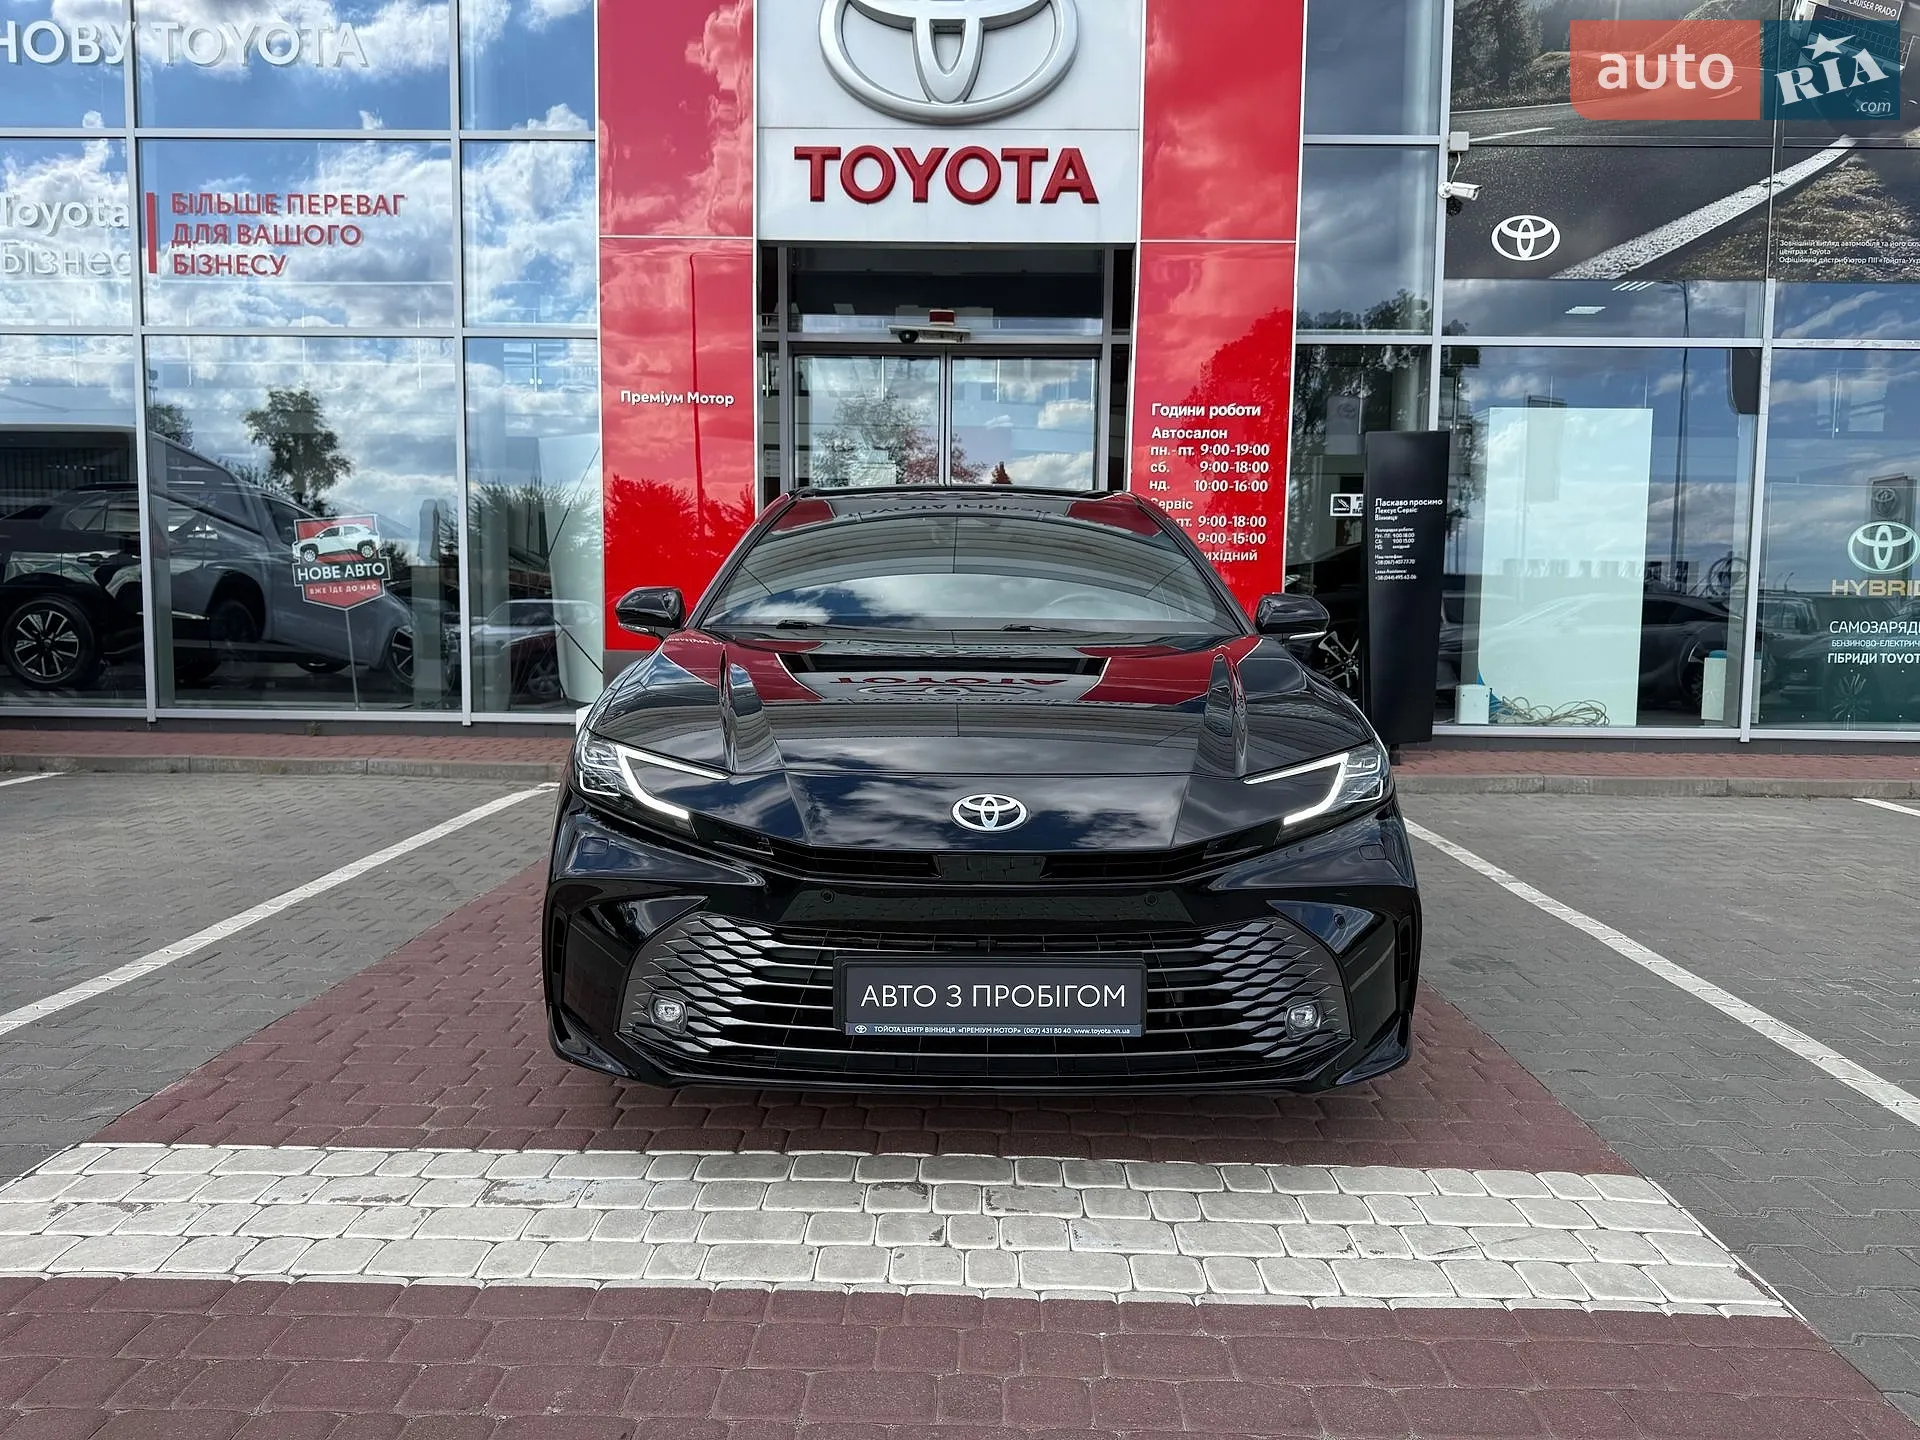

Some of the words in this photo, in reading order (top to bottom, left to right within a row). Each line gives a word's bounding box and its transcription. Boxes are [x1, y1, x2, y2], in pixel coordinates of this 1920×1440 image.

[1874, 3, 1897, 17] PRADO
[150, 21, 367, 67] TOYOTA
[794, 145, 1099, 205] TOYOTA
[170, 192, 279, 215] БІЛЬШЕ
[287, 193, 406, 216] ПЕРЕВАГ
[171, 223, 229, 249] ДЛЯ
[237, 223, 363, 246] ВАШОГО
[1808, 248, 1831, 256] Toyota
[173, 253, 287, 276] БІЗНЕСУ
[620, 390, 684, 407] Преміум
[687, 391, 735, 408] Мотор
[1151, 402, 1205, 418] Години
[1209, 402, 1261, 419] роботи
[1151, 426, 1228, 439] Автосалон
[1200, 443, 1270, 456] 9:00-19:00
[1150, 460, 1170, 473] сб.
[1199, 460, 1270, 473] 9:00-18:00
[1149, 480, 1171, 492] нд.
[1193, 479, 1269, 492] 10:00-16:00
[1375, 497, 1408, 507] Ласкаво
[1409, 499, 1443, 508] просимо
[1198, 515, 1267, 528] 9:00-18:00
[1197, 532, 1266, 545] 9:00-15:00
[1203, 549, 1258, 563] ихідний
[297, 565, 341, 581] НОВЕ
[344, 562, 385, 578] АВТО
[360, 583, 377, 591] НАС
[1829, 620, 1920, 635] САМОЗАРЯД
[1827, 652, 1877, 665] ГІБРИДИ
[1880, 653, 1920, 664] TOYOT
[860, 984, 937, 1007] АВТО
[945, 984, 962, 1007] З
[972, 984, 1125, 1007] ПРОБІГОМ
[874, 1025, 901, 1033] ТОЙОТА
[902, 1026, 924, 1034] ЦЕНТР
[924, 1026, 956, 1034] ВІННИЦЯ
[1023, 1027, 1041, 1035] (067)
[1073, 1028, 1131, 1036] www.toyota.vn.ua
